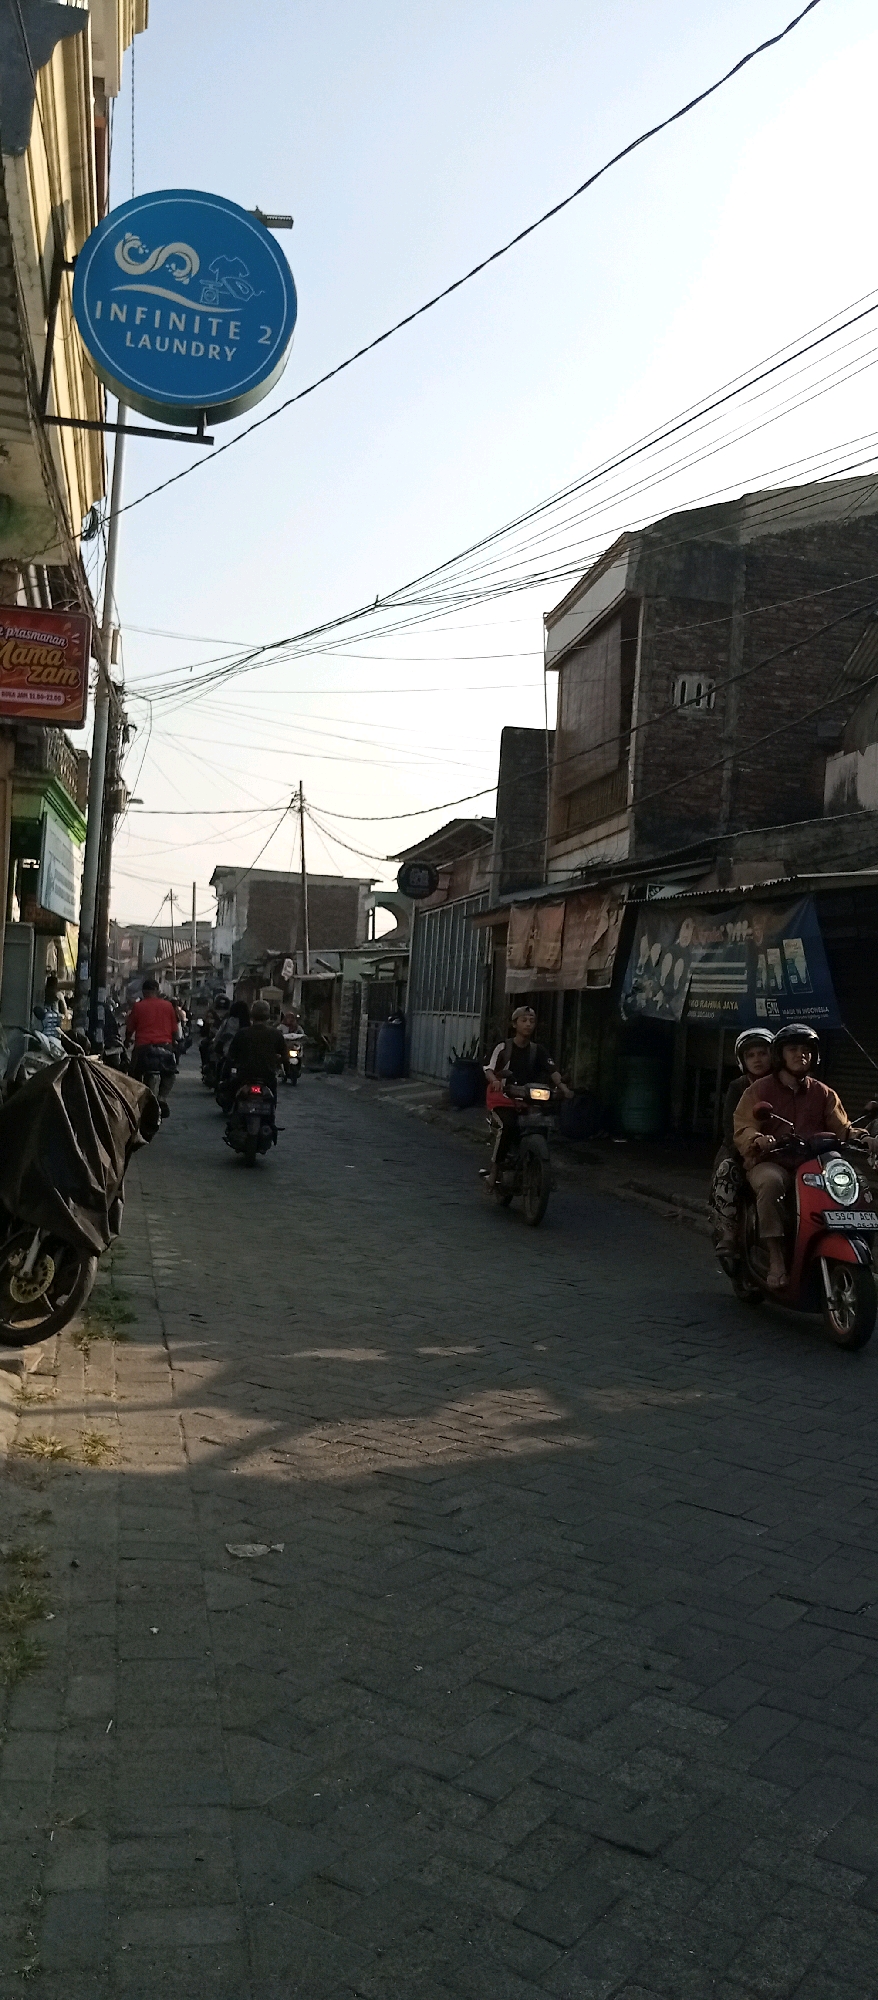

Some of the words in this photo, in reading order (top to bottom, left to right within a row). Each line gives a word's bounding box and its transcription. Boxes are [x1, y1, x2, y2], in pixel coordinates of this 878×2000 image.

[94, 299, 242, 341] INFINITE
[257, 325, 273, 345] 2
[125, 331, 237, 362] LAUNDRY
[5, 627, 67, 647] prasmanan
[27, 665, 78, 686] zam
[722, 1000, 739, 1011] JAYA
[827, 1213, 834, 1221] L
